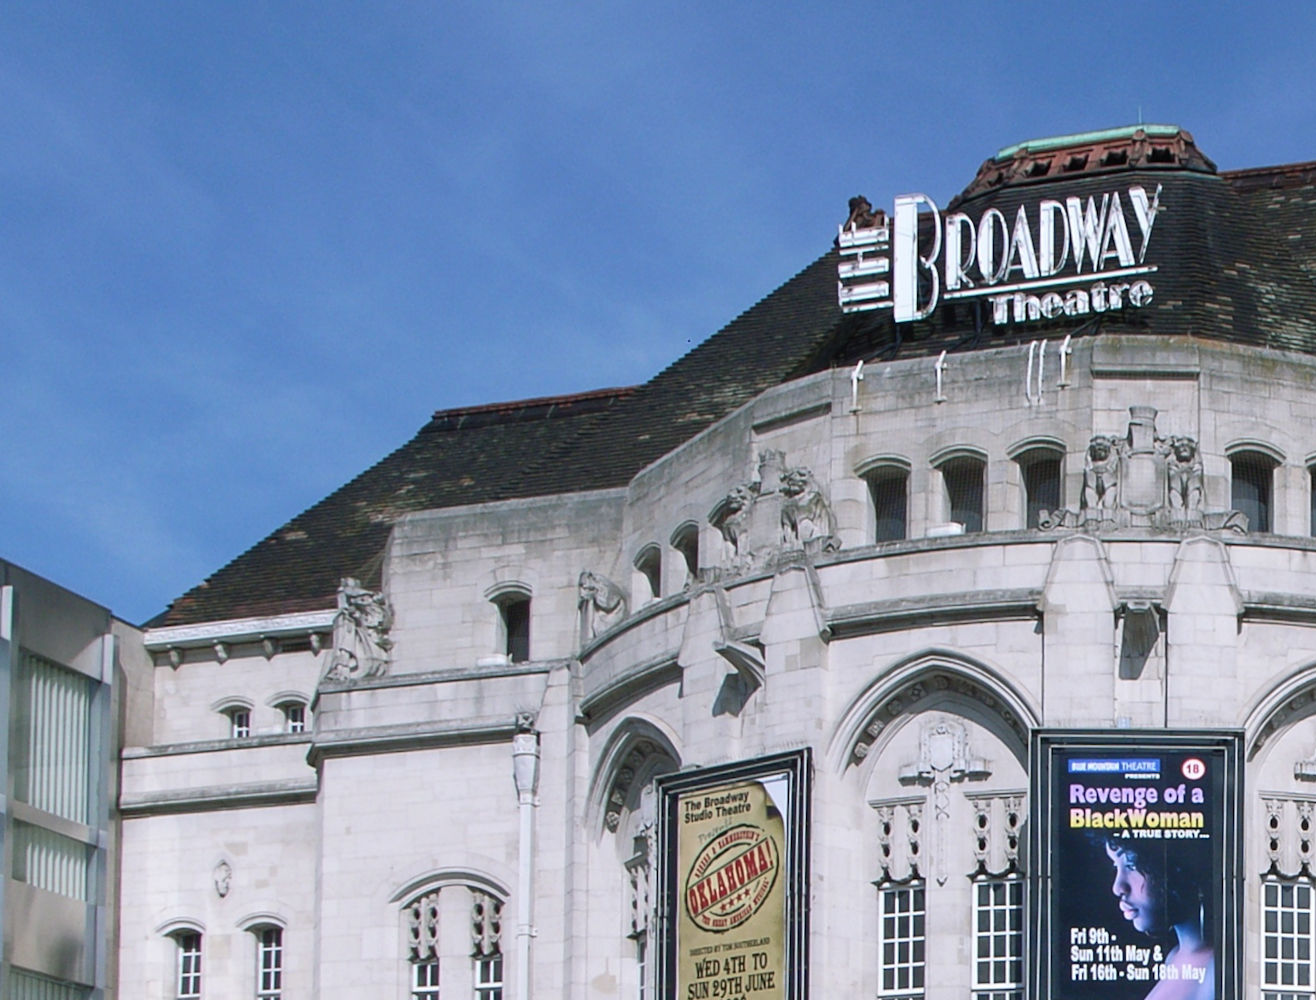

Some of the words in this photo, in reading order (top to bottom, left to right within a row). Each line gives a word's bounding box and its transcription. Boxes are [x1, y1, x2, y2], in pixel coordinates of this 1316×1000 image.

[838, 214, 893, 314] THE
[894, 183, 1163, 323] BROADWAY
[988, 281, 1154, 324] Theatre
[1121, 762, 1157, 771] THEATRE
[1186, 764, 1199, 774] 18
[684, 801, 701, 812] The
[704, 792, 749, 809] Broadway
[1069, 784, 1158, 809] Revenge
[1163, 783, 1186, 803] of
[1191, 788, 1204, 803] a
[684, 809, 713, 824] Studio
[715, 802, 751, 818] Theatre
[1069, 808, 1204, 828] BlackWoman
[1121, 830, 1130, 838] A
[1132, 830, 1161, 838] TRUE
[688, 839, 774, 918] OKLAHOMA!
[1070, 928, 1087, 944] Fri
[1088, 928, 1109, 944] 9th
[1070, 945, 1094, 962] Sun
[1096, 945, 1123, 962] 11th
[1125, 945, 1151, 965] May
[1152, 945, 1163, 962] &
[695, 957, 720, 979] WED
[723, 955, 746, 975] 4TH
[752, 952, 768, 970] TO
[1071, 964, 1087, 981] Fri
[1090, 964, 1117, 981] 16th
[1126, 964, 1149, 981] Sun
[1152, 964, 1179, 981] 18th
[1181, 964, 1206, 984] May
[687, 981, 709, 1000] SUN
[712, 976, 742, 998] 29TH
[745, 971, 775, 992] JUNE
